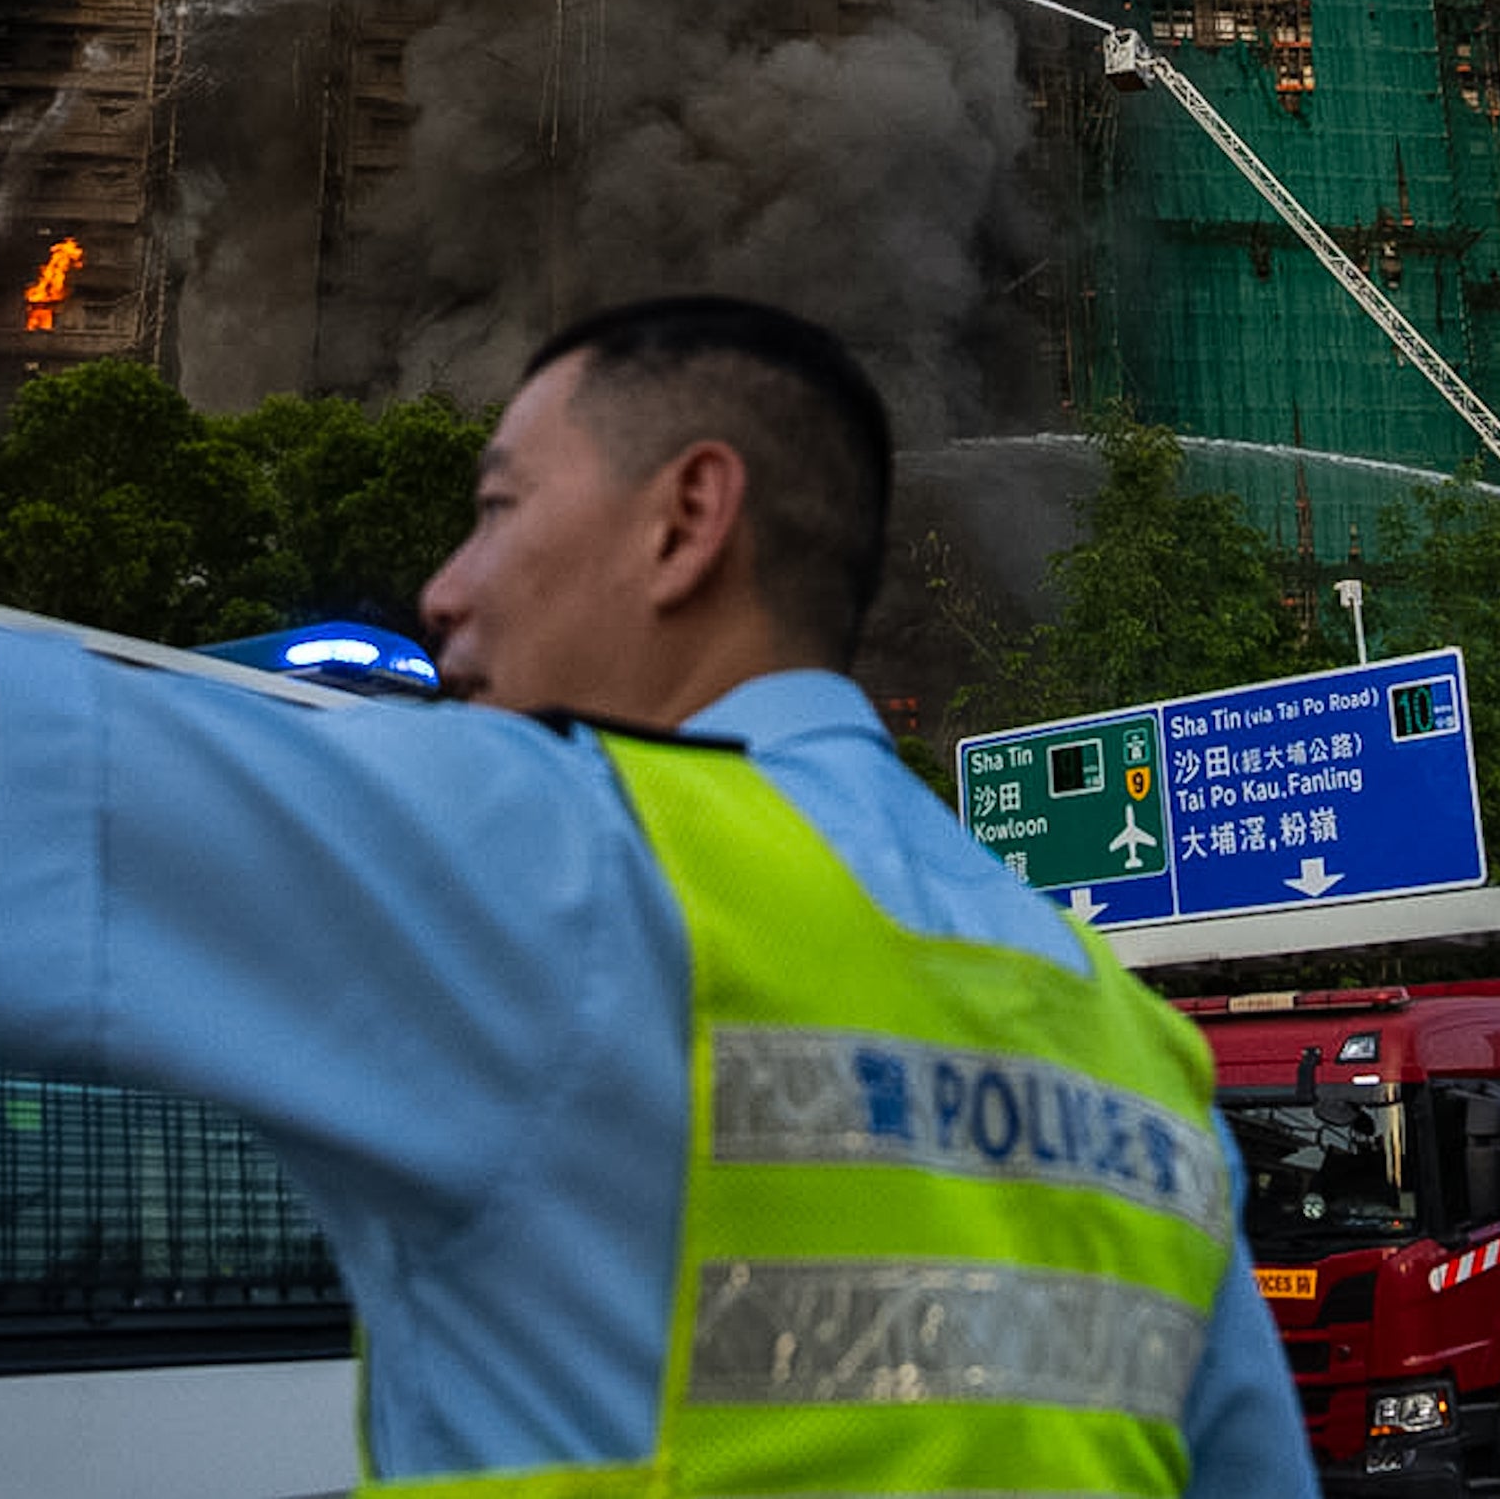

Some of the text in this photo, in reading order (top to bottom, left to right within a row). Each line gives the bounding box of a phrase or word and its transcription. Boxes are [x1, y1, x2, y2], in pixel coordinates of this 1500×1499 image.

[1171, 686, 1379, 739] Sha Tin (via Tai Po Road)
[1399, 686, 1433, 734] 10
[971, 747, 1033, 775] Sha Tin
[1132, 771, 1144, 794] 9
[973, 782, 1021, 817] 沙田
[1176, 788, 1205, 812] Tai
[1210, 786, 1236, 808] Po
[974, 817, 1048, 842] Kowloon
